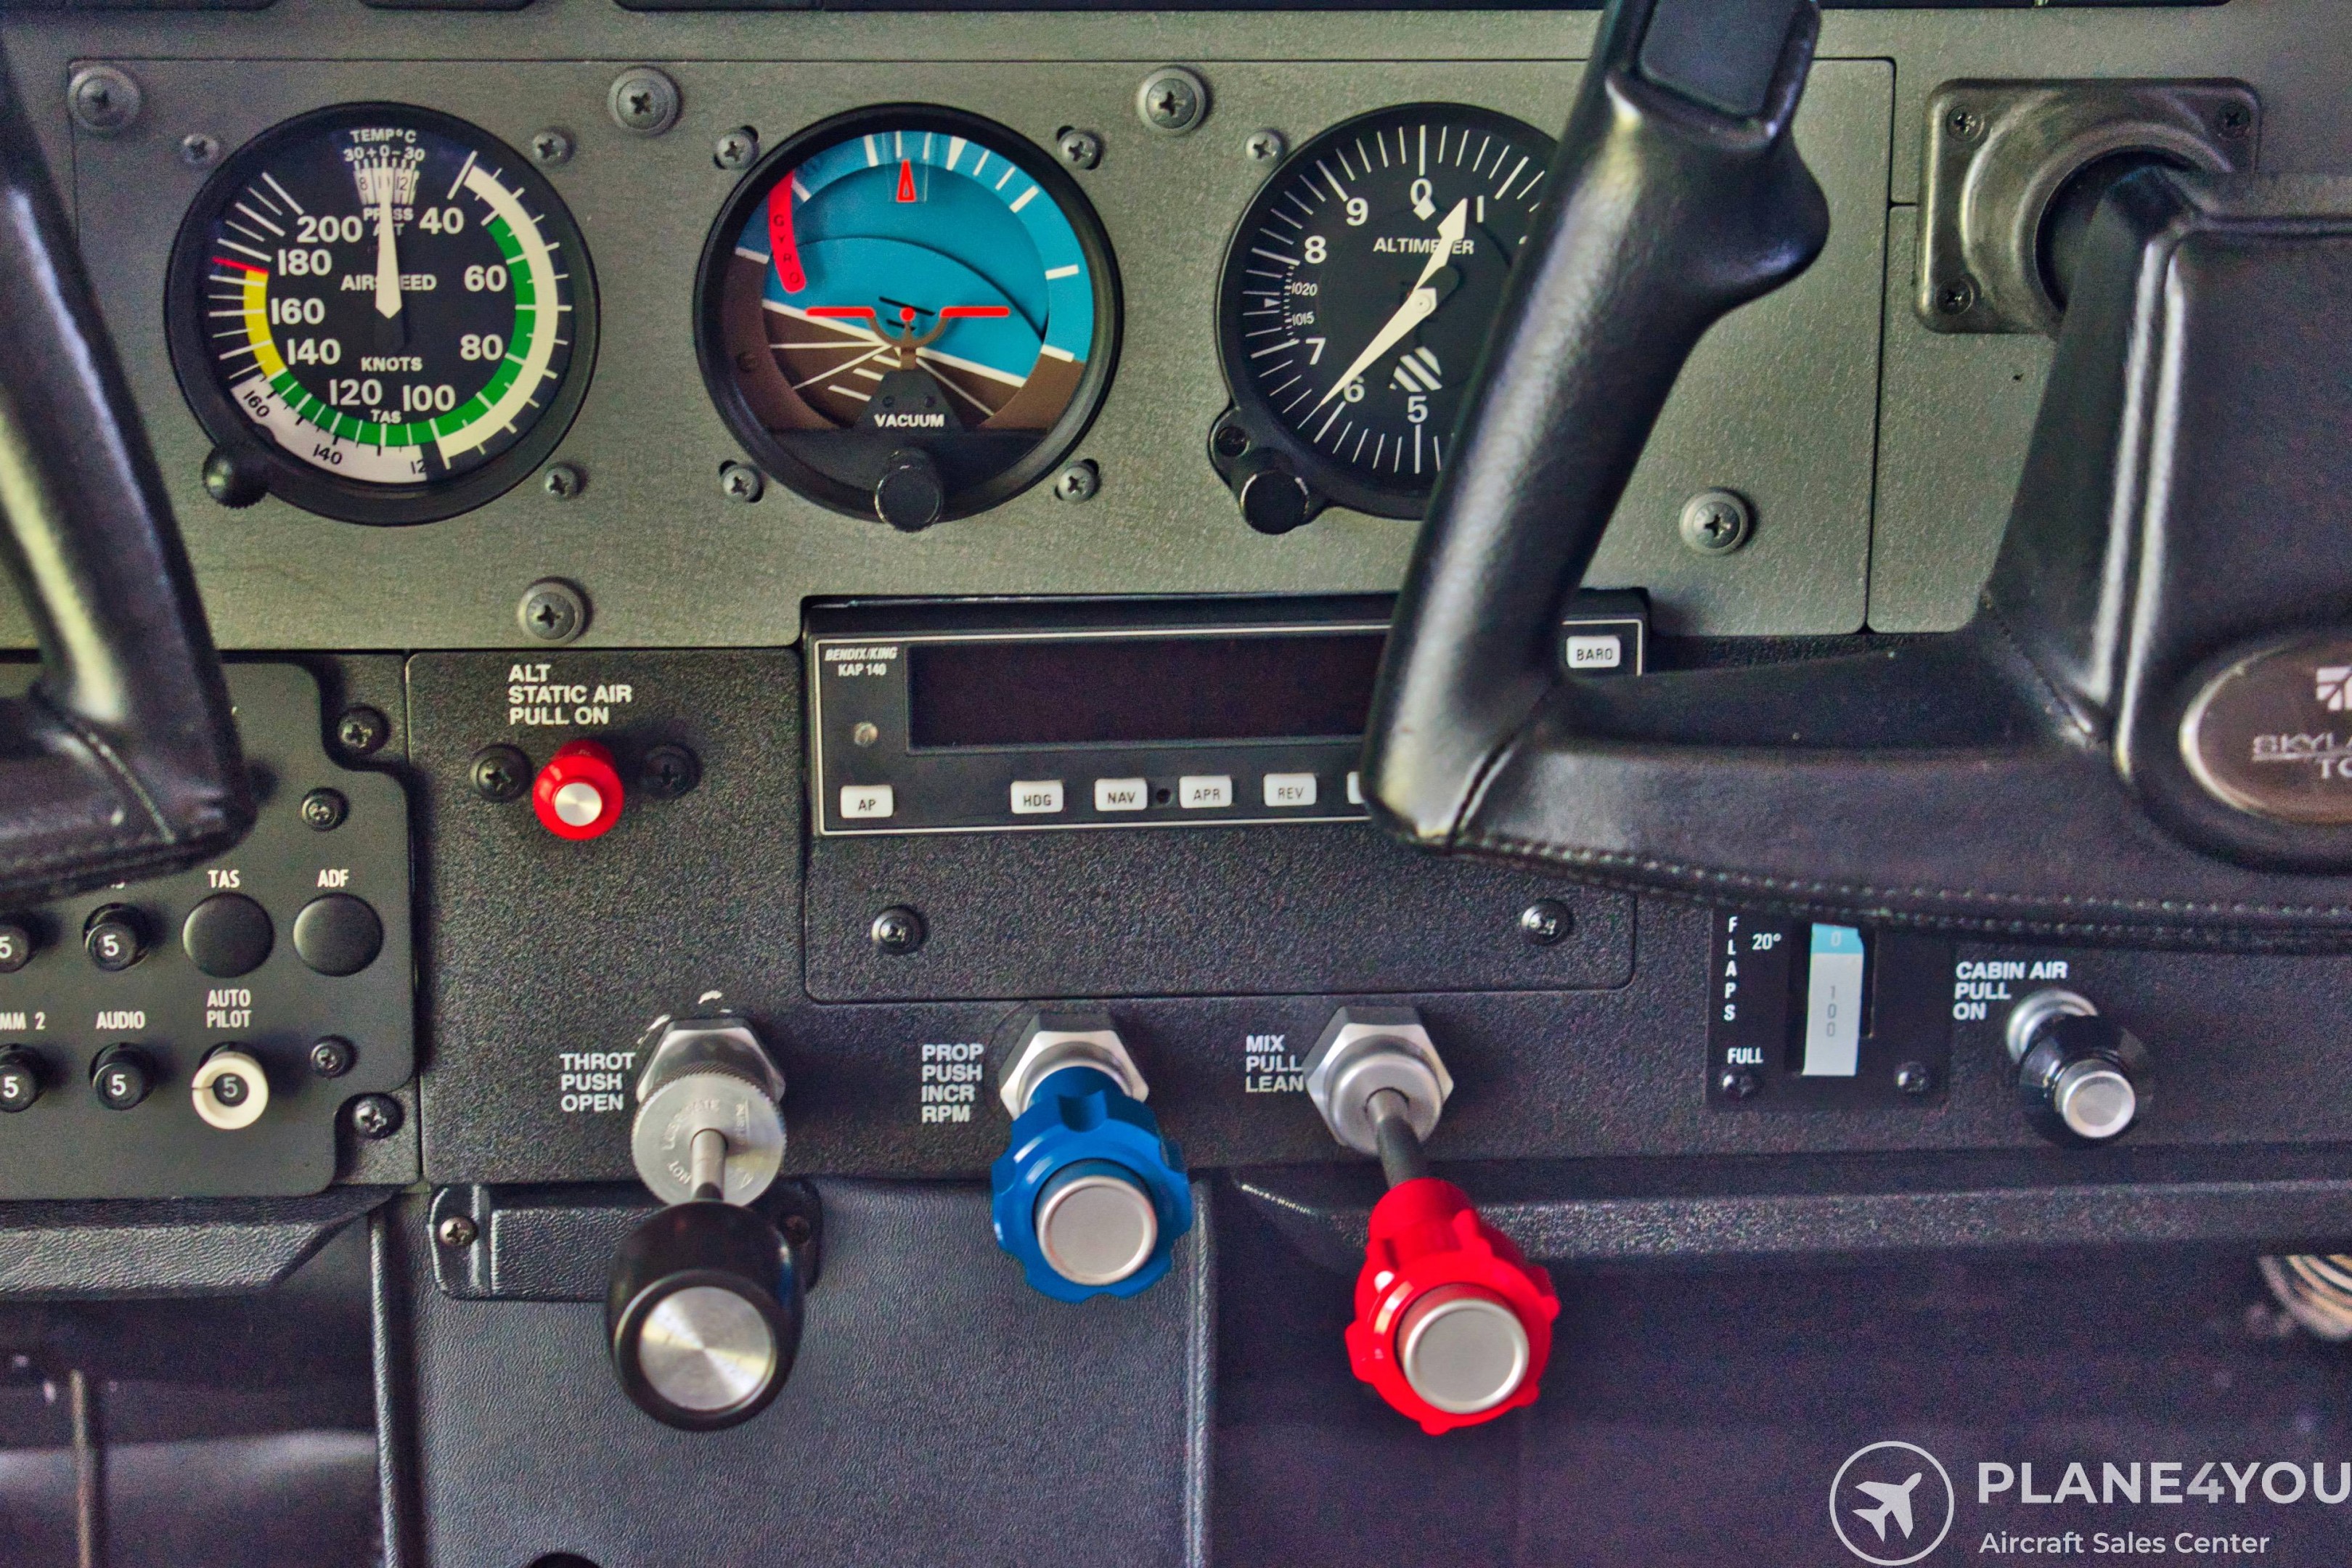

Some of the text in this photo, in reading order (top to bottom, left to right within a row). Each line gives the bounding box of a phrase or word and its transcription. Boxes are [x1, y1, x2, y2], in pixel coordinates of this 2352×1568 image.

[343, 147, 364, 162] 30
[379, 144, 390, 158] 0
[404, 146, 425, 162] 30
[363, 208, 414, 221] PRSS
[419, 207, 464, 234] 40
[1345, 197, 1368, 226] 9
[296, 215, 363, 243] 200
[1304, 235, 1327, 264] 8
[1373, 237, 1474, 255] ALTIMEER
[278, 249, 332, 276] 180
[340, 274, 437, 291] AIREED
[464, 265, 507, 291] 60
[1291, 282, 1318, 297] 1020
[271, 298, 325, 324] 160
[1292, 311, 1315, 326] 1015
[287, 338, 341, 365] 140
[460, 334, 503, 361] 80
[1305, 338, 1326, 365] 7
[361, 356, 422, 372] KNOTS
[330, 379, 383, 406] 120
[403, 385, 456, 412] 100
[1343, 375, 1365, 403] 6
[243, 391, 270, 418] 160
[1407, 396, 1429, 423] 5
[370, 409, 402, 424] TAS
[874, 413, 944, 428] VACUUM
[312, 444, 343, 466] 140
[825, 646, 898, 661] BENDIX/KING
[1576, 648, 1613, 661] BARO
[508, 663, 551, 682] ALT
[838, 663, 887, 677] KAP 140
[508, 685, 632, 704] STATIC AIR
[509, 706, 609, 725] PULL ON
[1024, 794, 1052, 807] HDG
[1108, 792, 1135, 804] NAV
[1193, 788, 1220, 801] APR
[1278, 787, 1304, 800] REV
[858, 799, 876, 811] AP
[208, 870, 240, 889] TAS
[317, 870, 349, 888] ADF
[102, 934, 120, 957] 5
[1723, 916, 1737, 1021] FLAPS
[1956, 961, 2068, 980] CABIN AIR
[207, 989, 251, 1008] AUTO
[1954, 982, 2012, 1000] PULL
[35, 1011, 46, 1030] 2
[96, 1010, 145, 1029] AUDIO
[206, 1009, 252, 1029] PILOT
[1953, 1002, 1986, 1021] ON
[922, 1043, 984, 1062] PROP
[1246, 1034, 1285, 1053] MIX
[559, 1052, 636, 1071] THROT
[1246, 1055, 1303, 1073] PULL
[1727, 1048, 1763, 1064] FULL
[560, 1072, 622, 1091] PUSH
[922, 1063, 982, 1082] PUSH
[3, 1076, 19, 1098] 5
[111, 1074, 126, 1096] 5
[224, 1077, 238, 1098] 5
[1245, 1074, 1304, 1093] LEAN
[560, 1093, 624, 1112] OPEN
[921, 1084, 975, 1103] INCR
[921, 1104, 971, 1123] RPM
